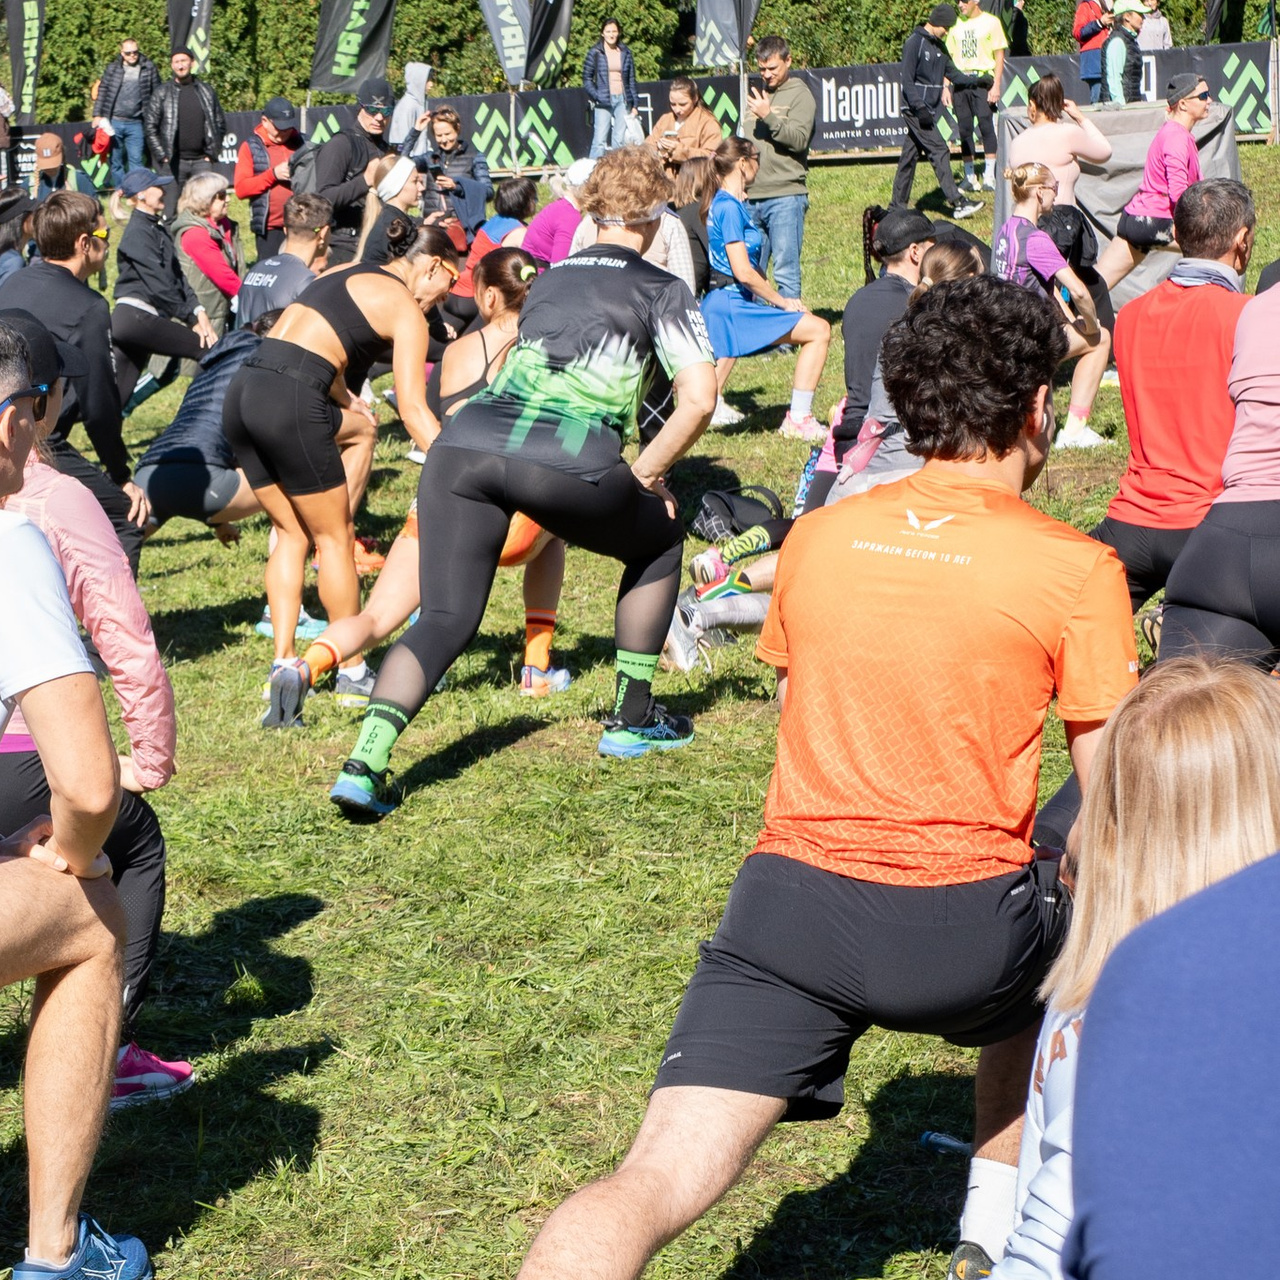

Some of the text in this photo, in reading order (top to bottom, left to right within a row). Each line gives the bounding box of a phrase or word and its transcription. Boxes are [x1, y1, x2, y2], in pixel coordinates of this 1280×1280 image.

[821, 75, 903, 128] Magniu
[823, 130, 862, 140] НАПИТКИ
[874, 126, 909, 137] ПОЛЬЗО
[851, 539, 972, 566] ЗАРЯЖАЕМ БЕГОМ 10 ЛЕТ
